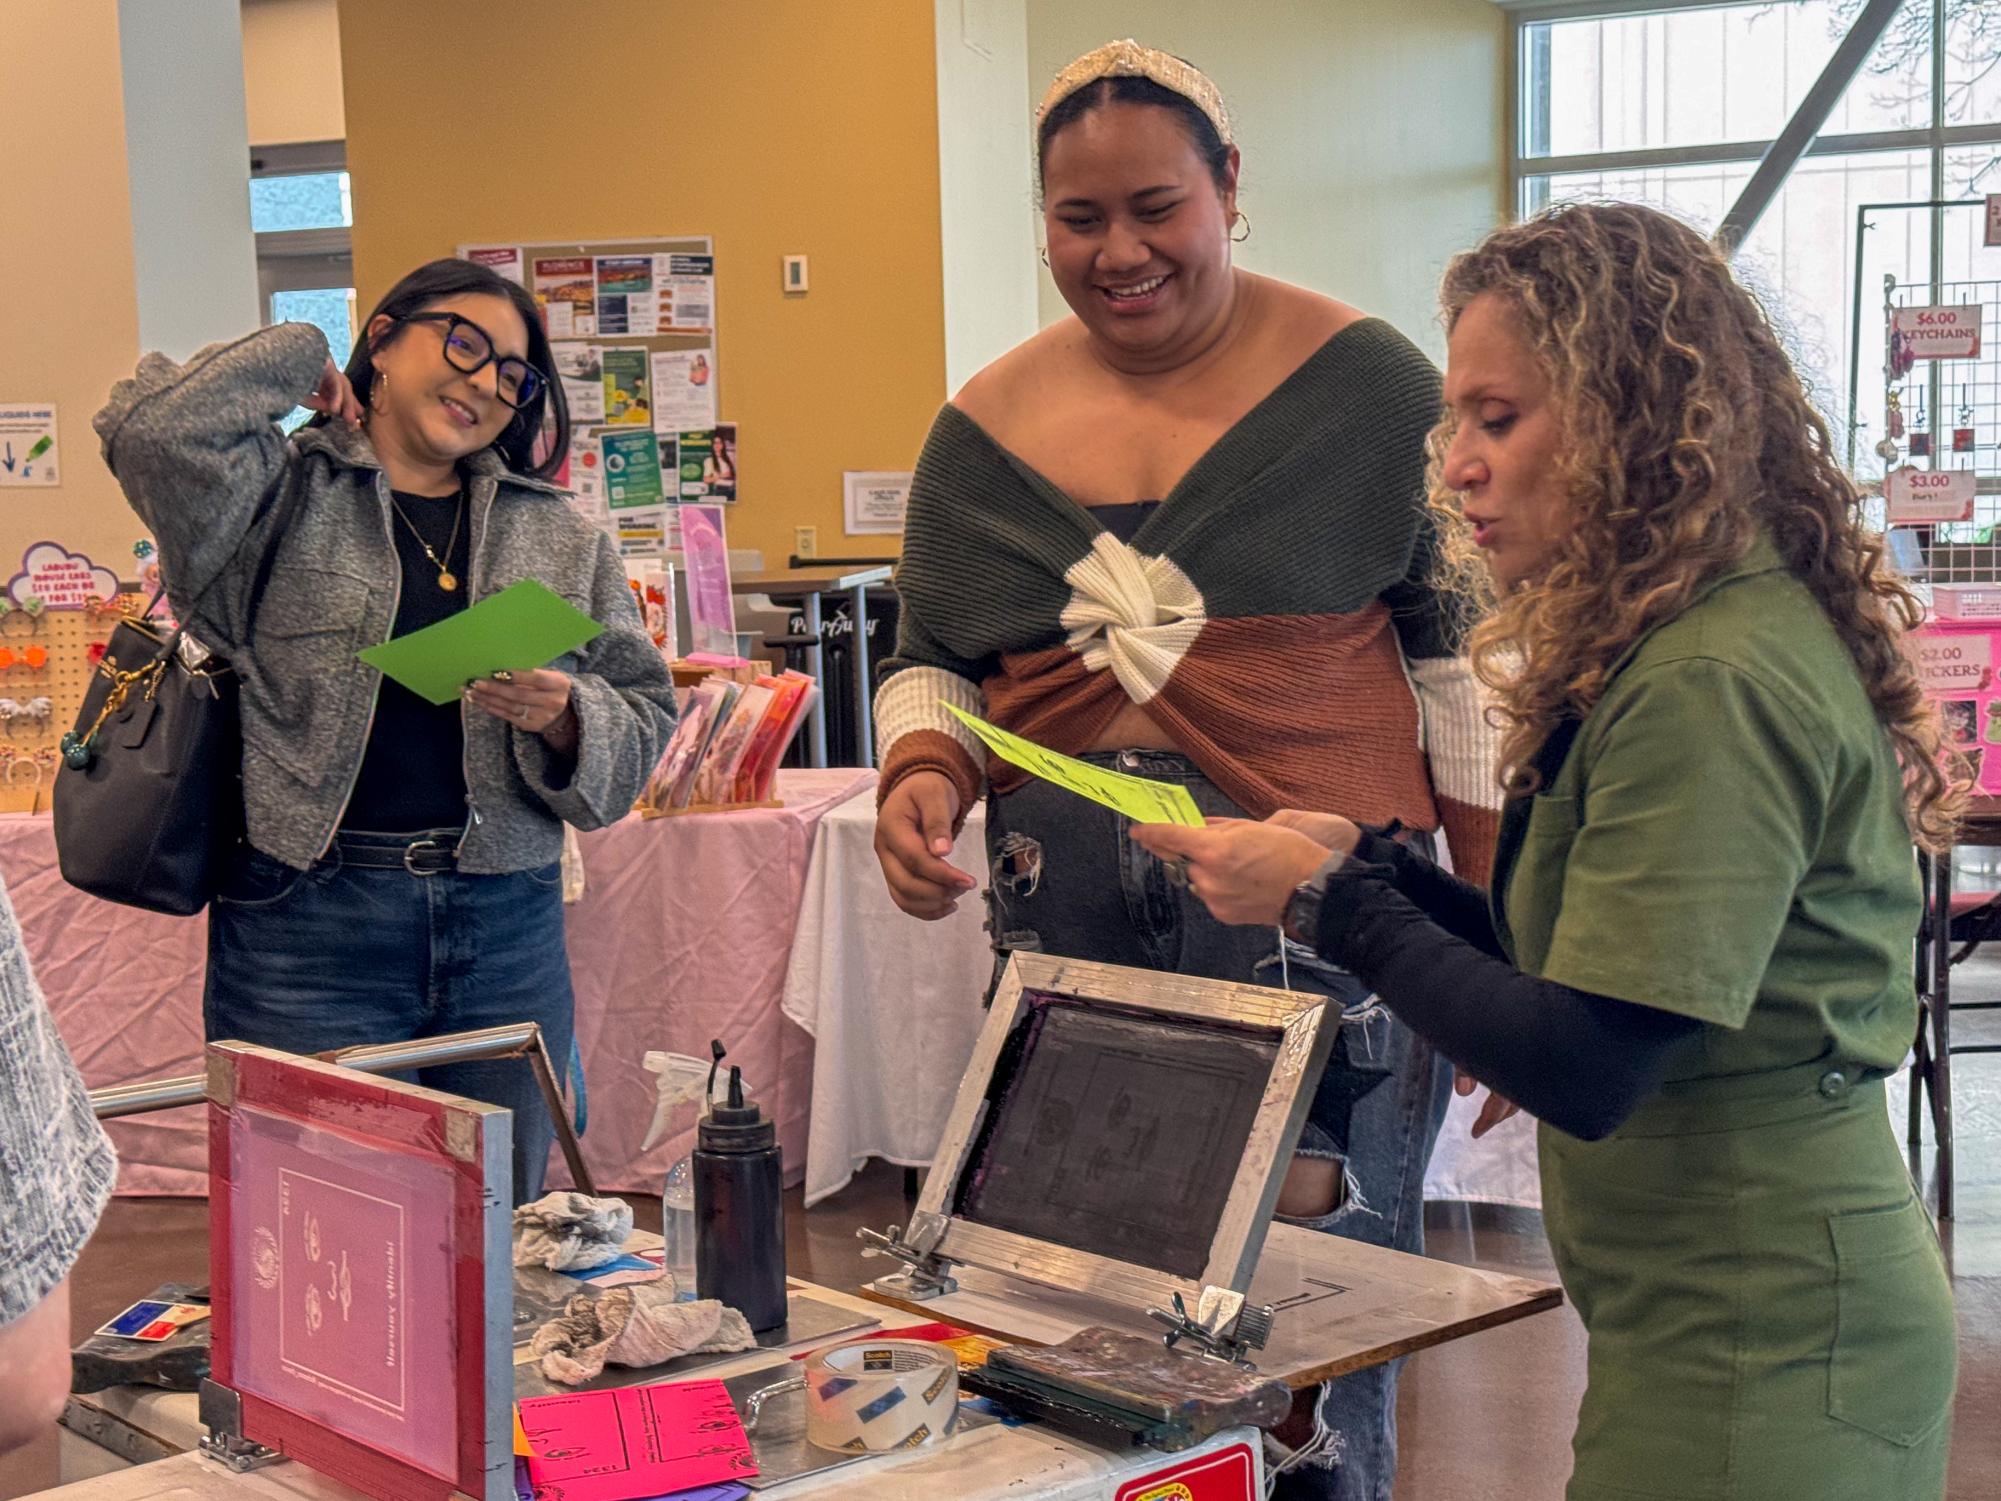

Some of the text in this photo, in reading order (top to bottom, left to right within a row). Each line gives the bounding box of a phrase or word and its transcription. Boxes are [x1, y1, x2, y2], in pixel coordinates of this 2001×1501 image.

[1917, 312, 1956, 325] $6.00
[1909, 475, 1949, 487] $3.00
[1921, 647, 1962, 661] $2.00
[1919, 664, 1981, 677] ICKERS
[865, 1351, 891, 1360] Scotch
